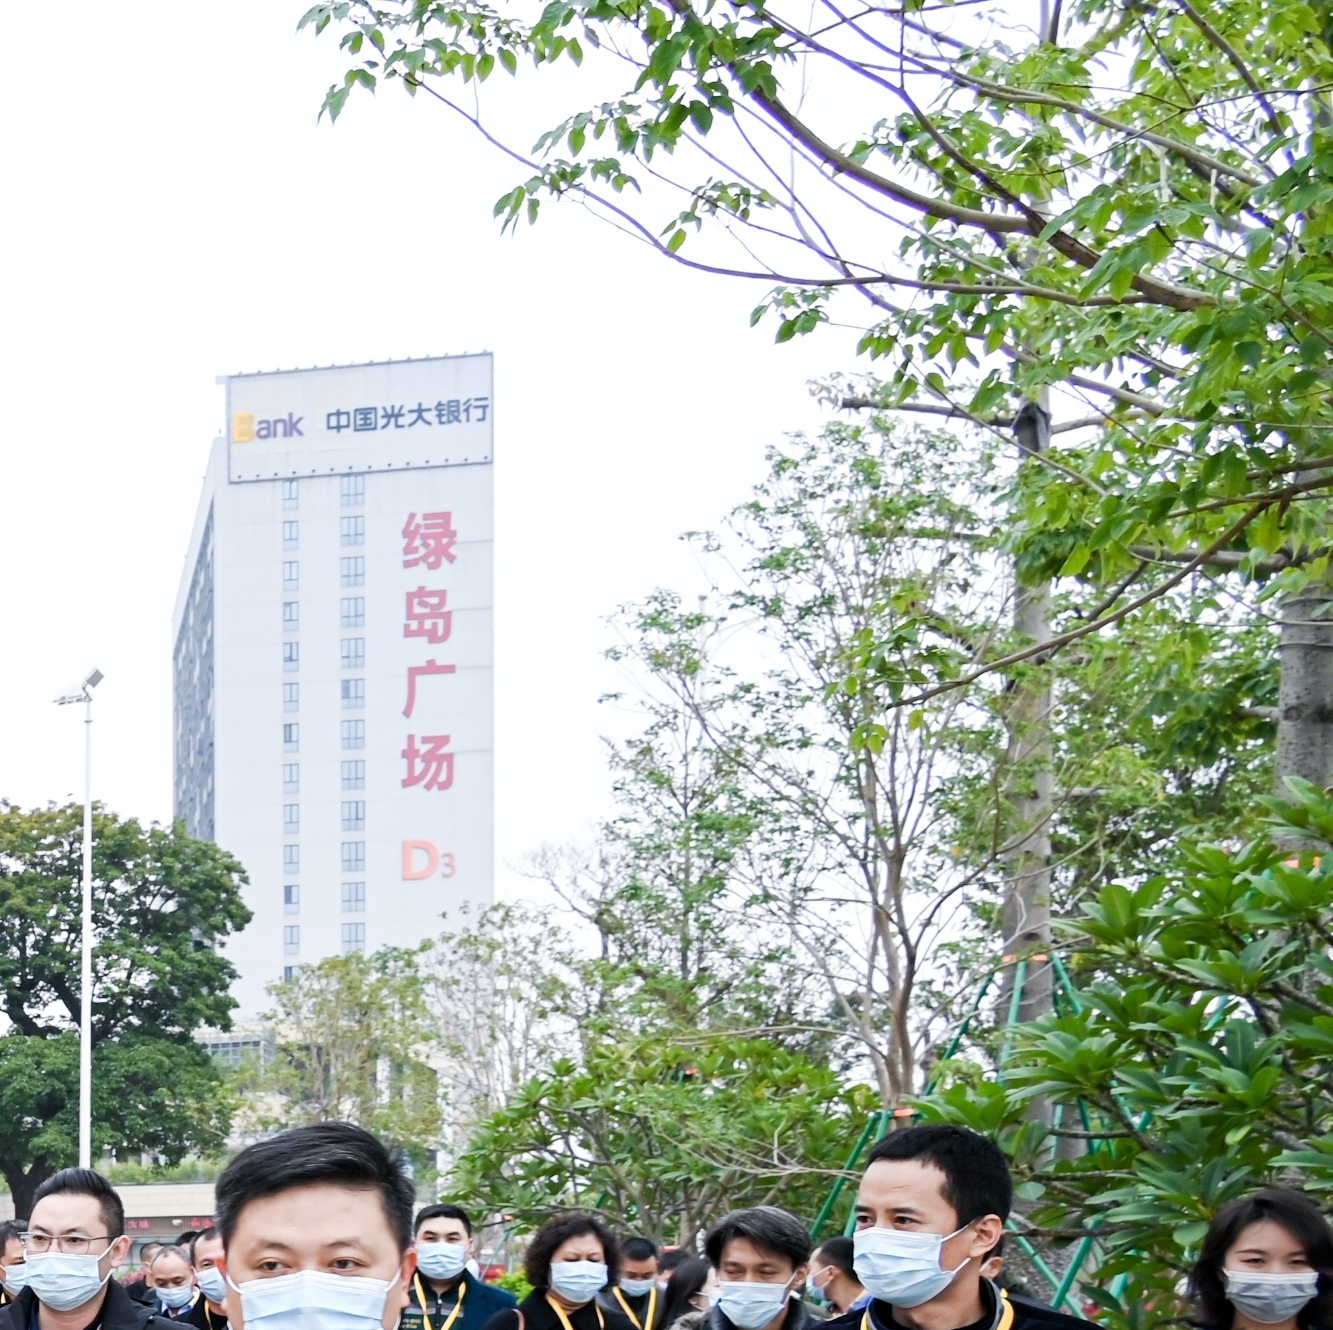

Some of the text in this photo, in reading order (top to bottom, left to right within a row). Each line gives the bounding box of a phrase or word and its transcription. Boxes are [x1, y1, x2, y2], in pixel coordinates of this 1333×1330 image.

[233, 412, 304, 443] Bank
[326, 397, 490, 434] 中国光大银行
[401, 511, 458, 792] 绿岛广场
